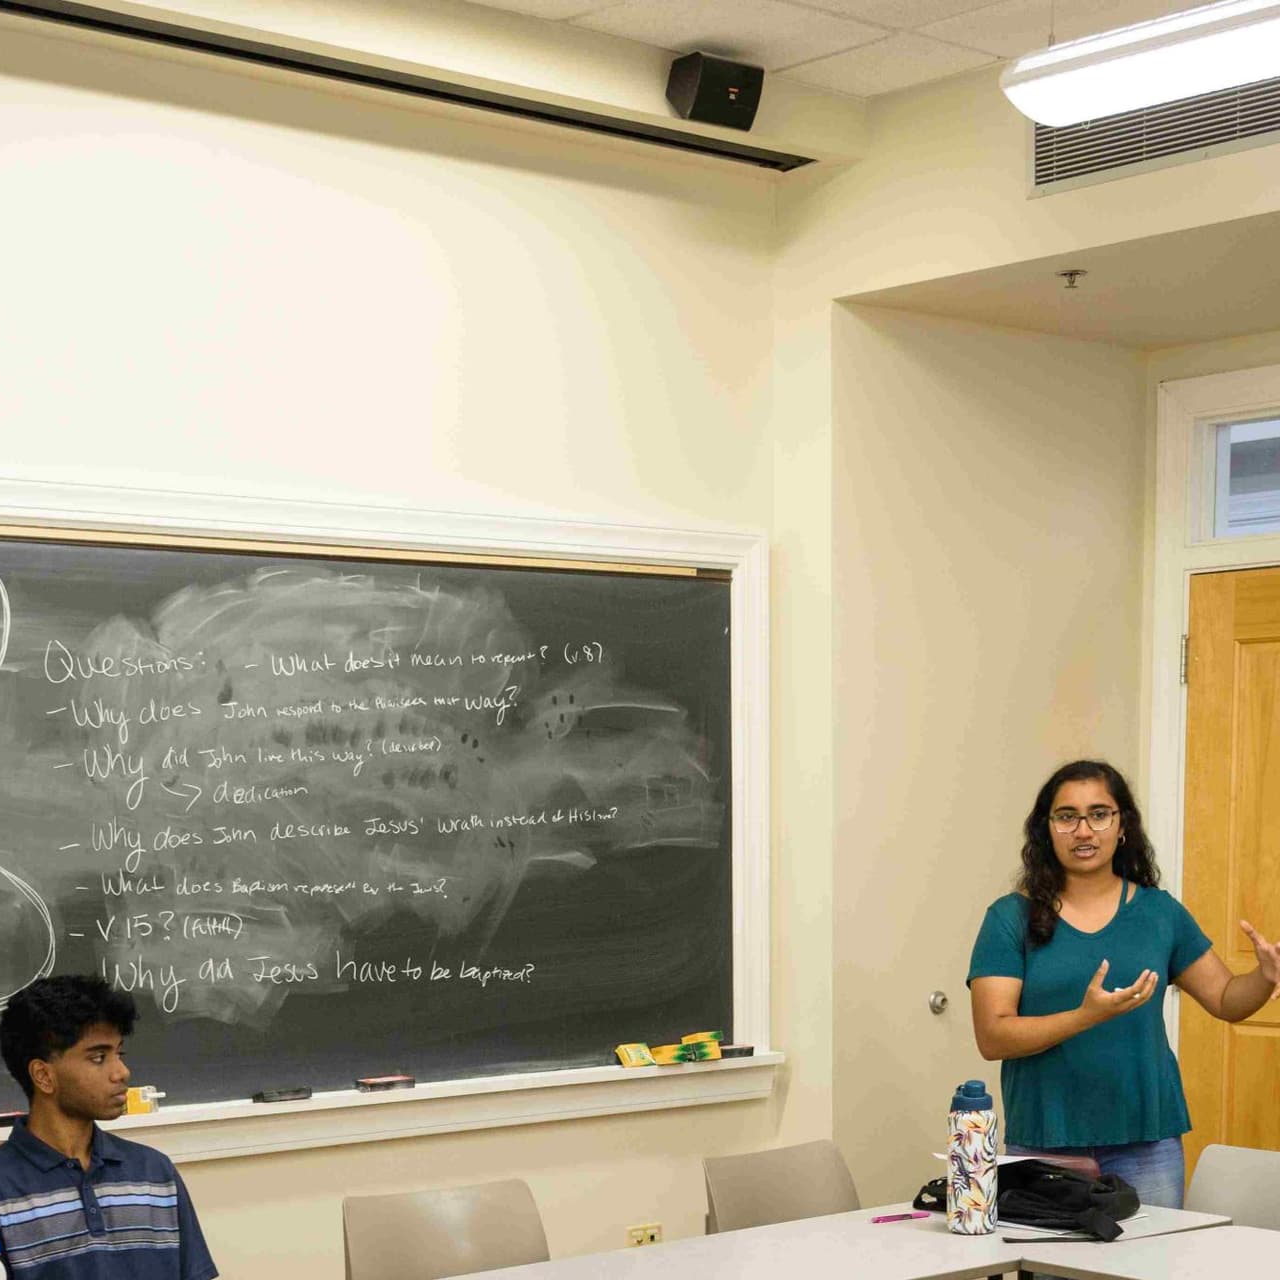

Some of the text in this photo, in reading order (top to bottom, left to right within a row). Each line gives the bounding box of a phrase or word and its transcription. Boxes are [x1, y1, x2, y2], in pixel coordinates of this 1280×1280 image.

[44, 640, 206, 683] Questions:
[272, 651, 337, 676] What
[344, 650, 385, 672] does
[387, 653, 400, 669] it
[411, 653, 463, 667] mean
[472, 655, 486, 665] to
[71, 699, 131, 744] Why
[139, 699, 202, 725] does
[222, 702, 268, 719] John
[277, 700, 322, 718] respond
[331, 702, 342, 713] to
[349, 699, 369, 711] the
[83, 744, 150, 810] Why
[162, 746, 190, 768] did
[198, 746, 247, 768] John
[291, 748, 325, 763] this
[91, 816, 147, 873] Why
[153, 825, 204, 851] does
[212, 826, 257, 845] John
[270, 820, 352, 841] describe
[490, 811, 546, 829] instead
[101, 867, 165, 896] What
[176, 876, 223, 896] does
[102, 954, 187, 1013] Why
[247, 956, 319, 984] Jesus
[336, 950, 397, 983] have
[401, 957, 423, 980] to
[431, 960, 452, 981] be
